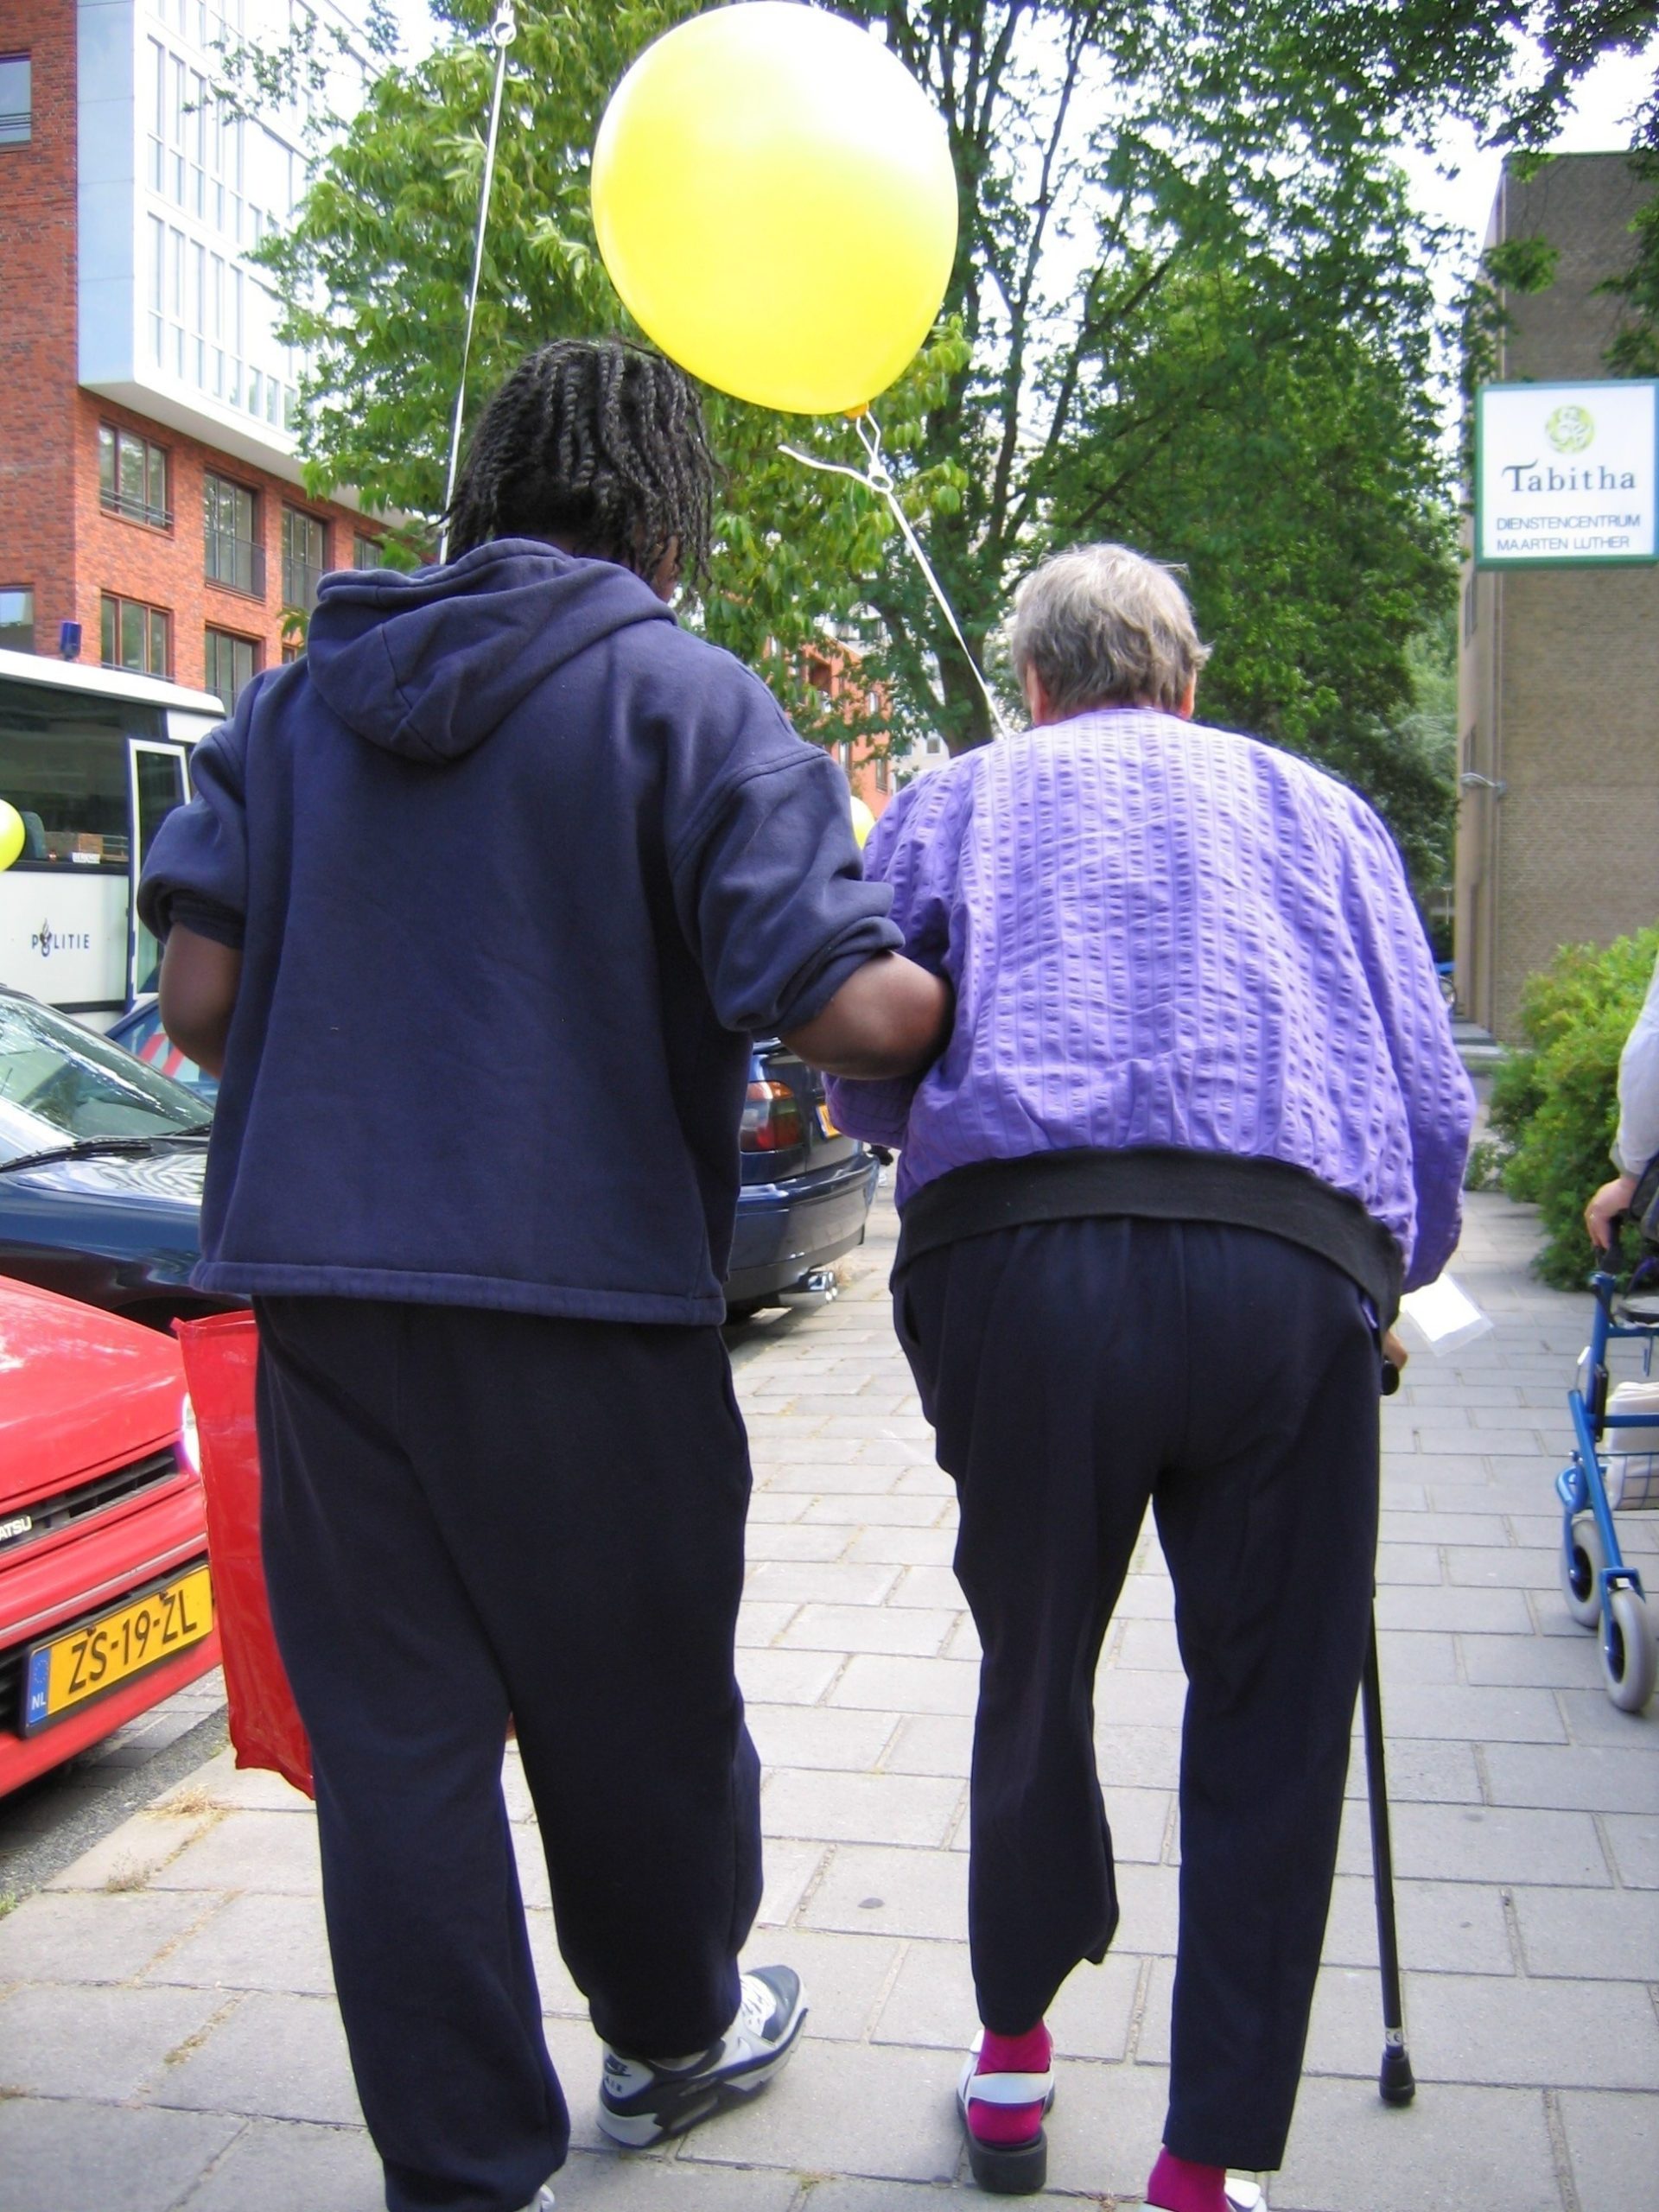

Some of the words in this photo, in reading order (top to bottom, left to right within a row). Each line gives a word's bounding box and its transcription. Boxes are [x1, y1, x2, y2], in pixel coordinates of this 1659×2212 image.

[1502, 459, 1637, 492] Tabitha
[1497, 515, 1641, 531] DIENSTENCENTRUM
[1497, 537, 1568, 550] MAARTEN
[1574, 536, 1630, 550] LUTHER
[68, 1590, 197, 1694] ZS-19-ZL
[31, 1693, 47, 1710] NL
